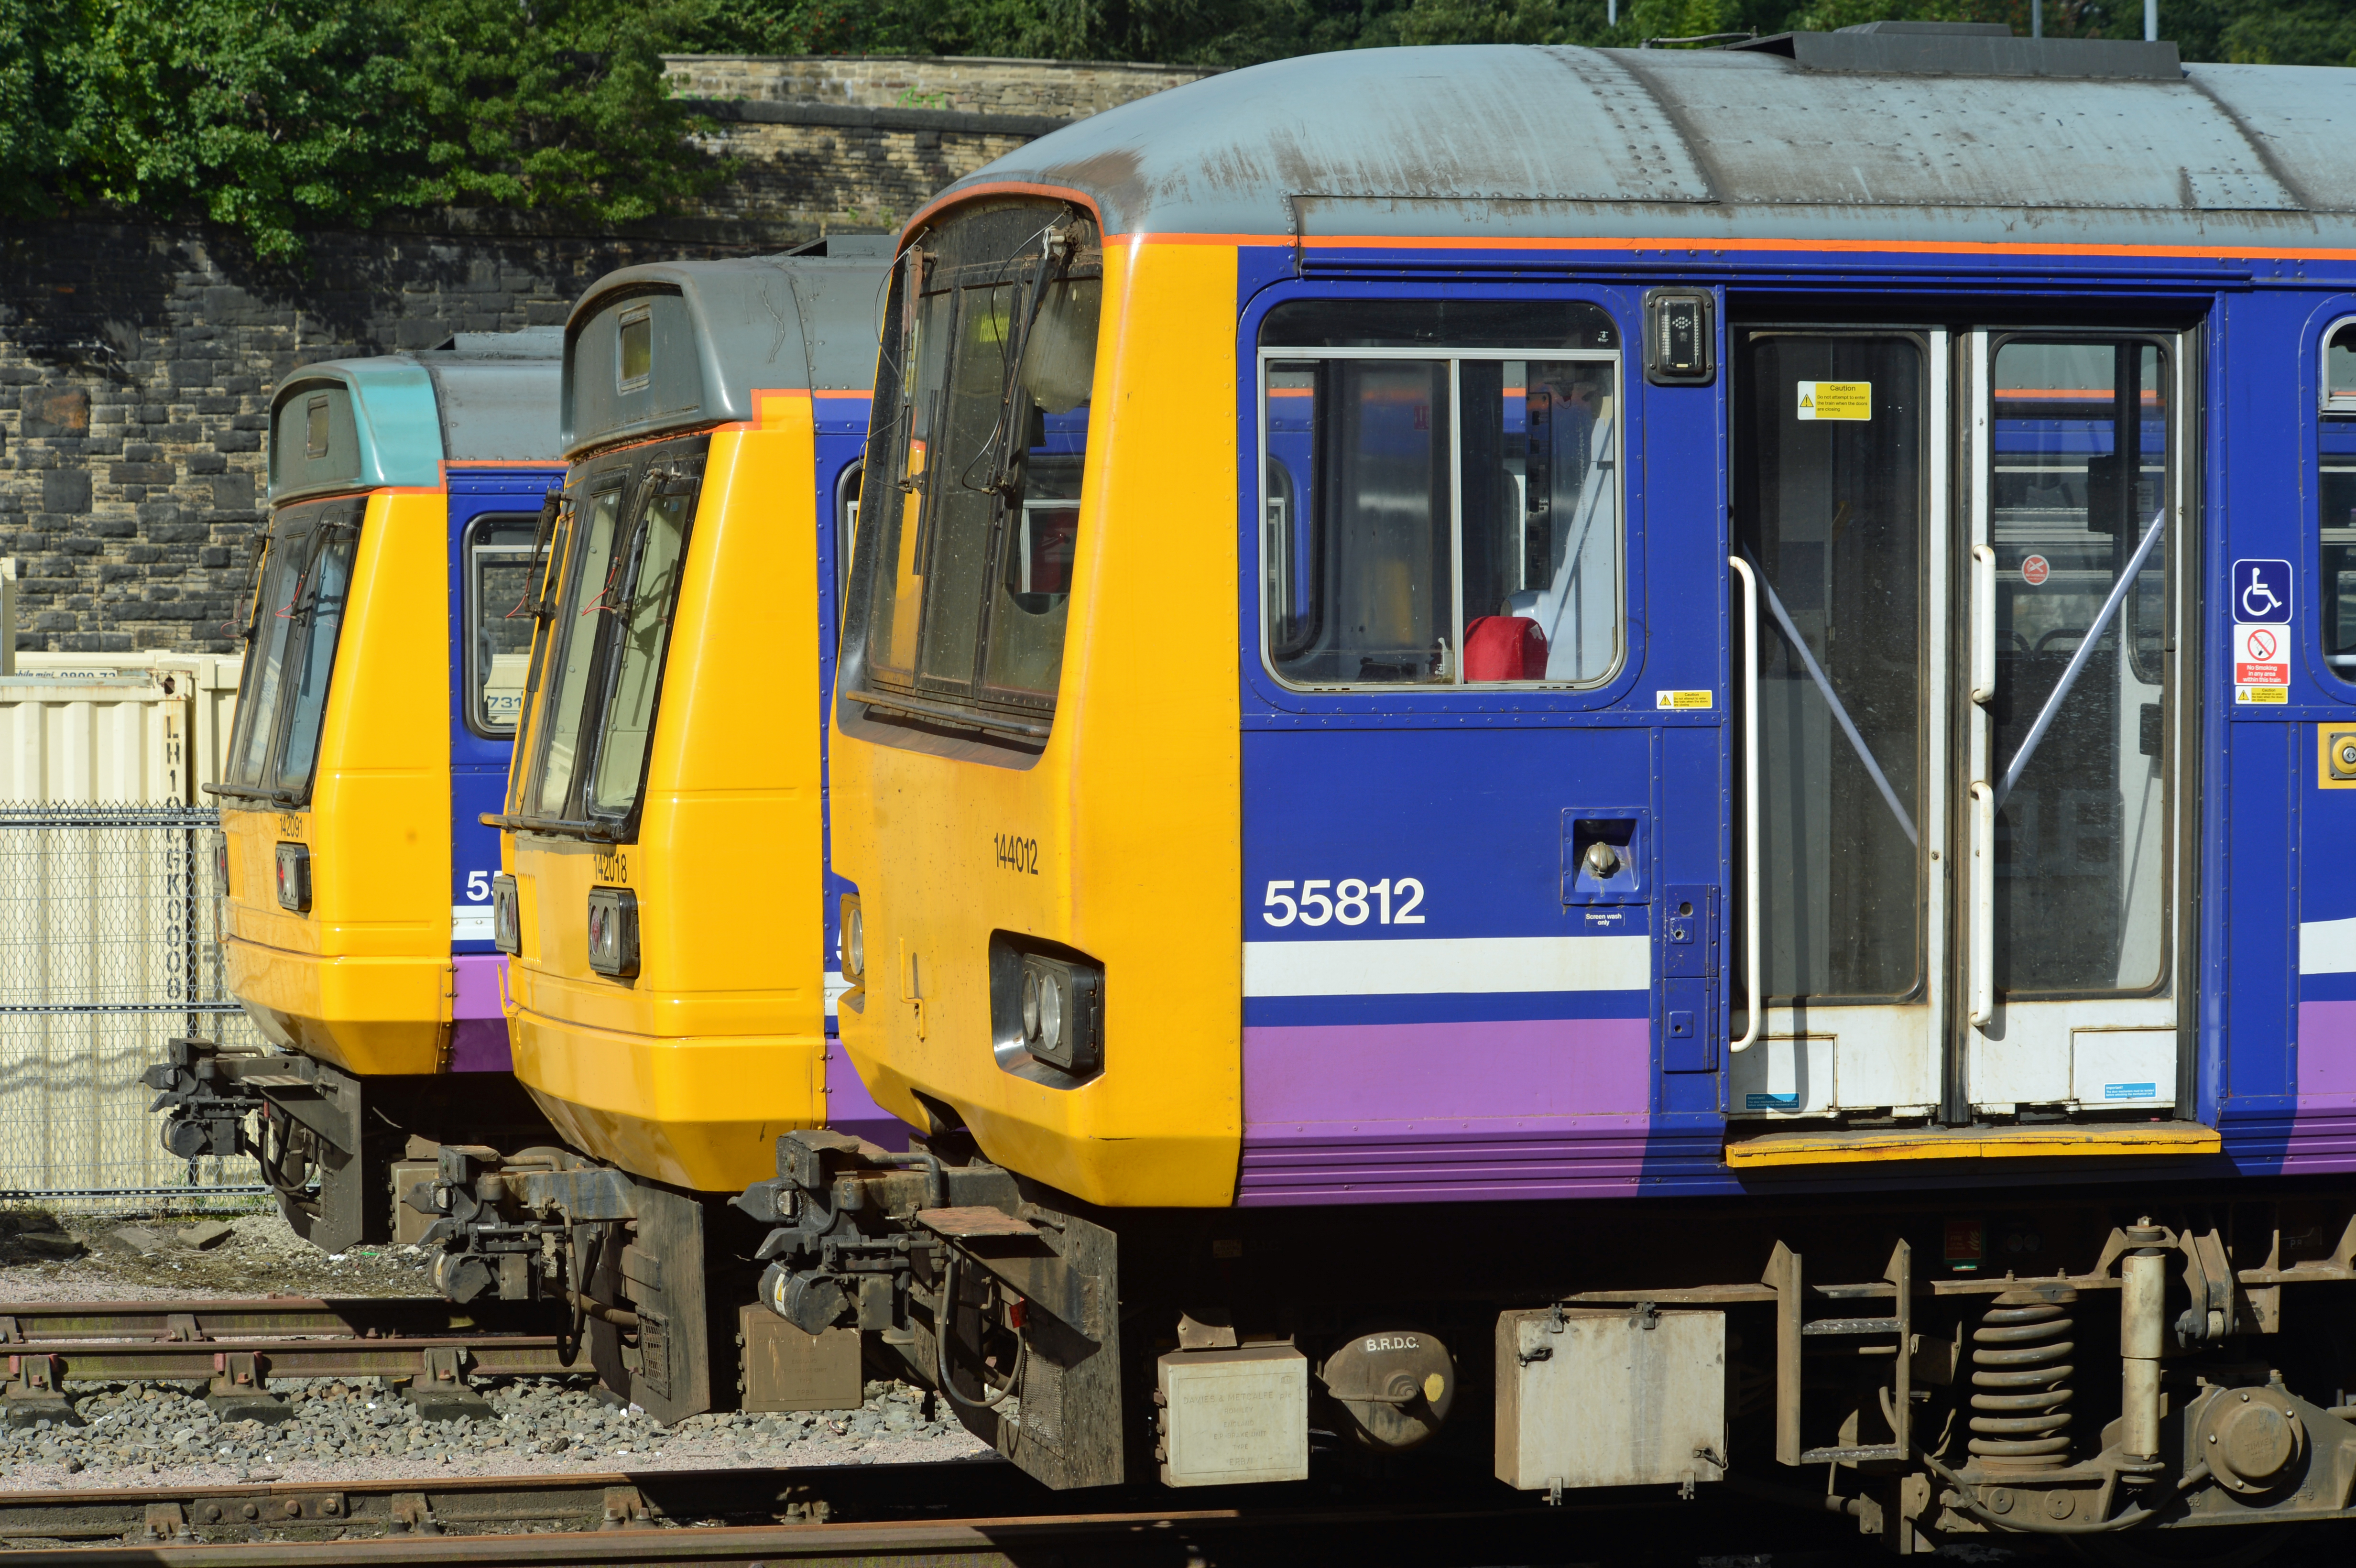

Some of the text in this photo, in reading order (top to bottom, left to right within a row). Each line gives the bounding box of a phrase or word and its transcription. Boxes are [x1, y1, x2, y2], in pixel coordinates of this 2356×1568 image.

[280, 815, 302, 838] 142091
[593, 851, 627, 883] 142018
[994, 832, 1038, 875] 144012
[1263, 878, 1425, 927] 55812
[1366, 1337, 1419, 1351] B.R.D.C.
[1183, 1395, 1215, 1404] DAVIES
[1228, 1392, 1273, 1401] METCALFE
[1280, 1391, 1291, 1401] plc
